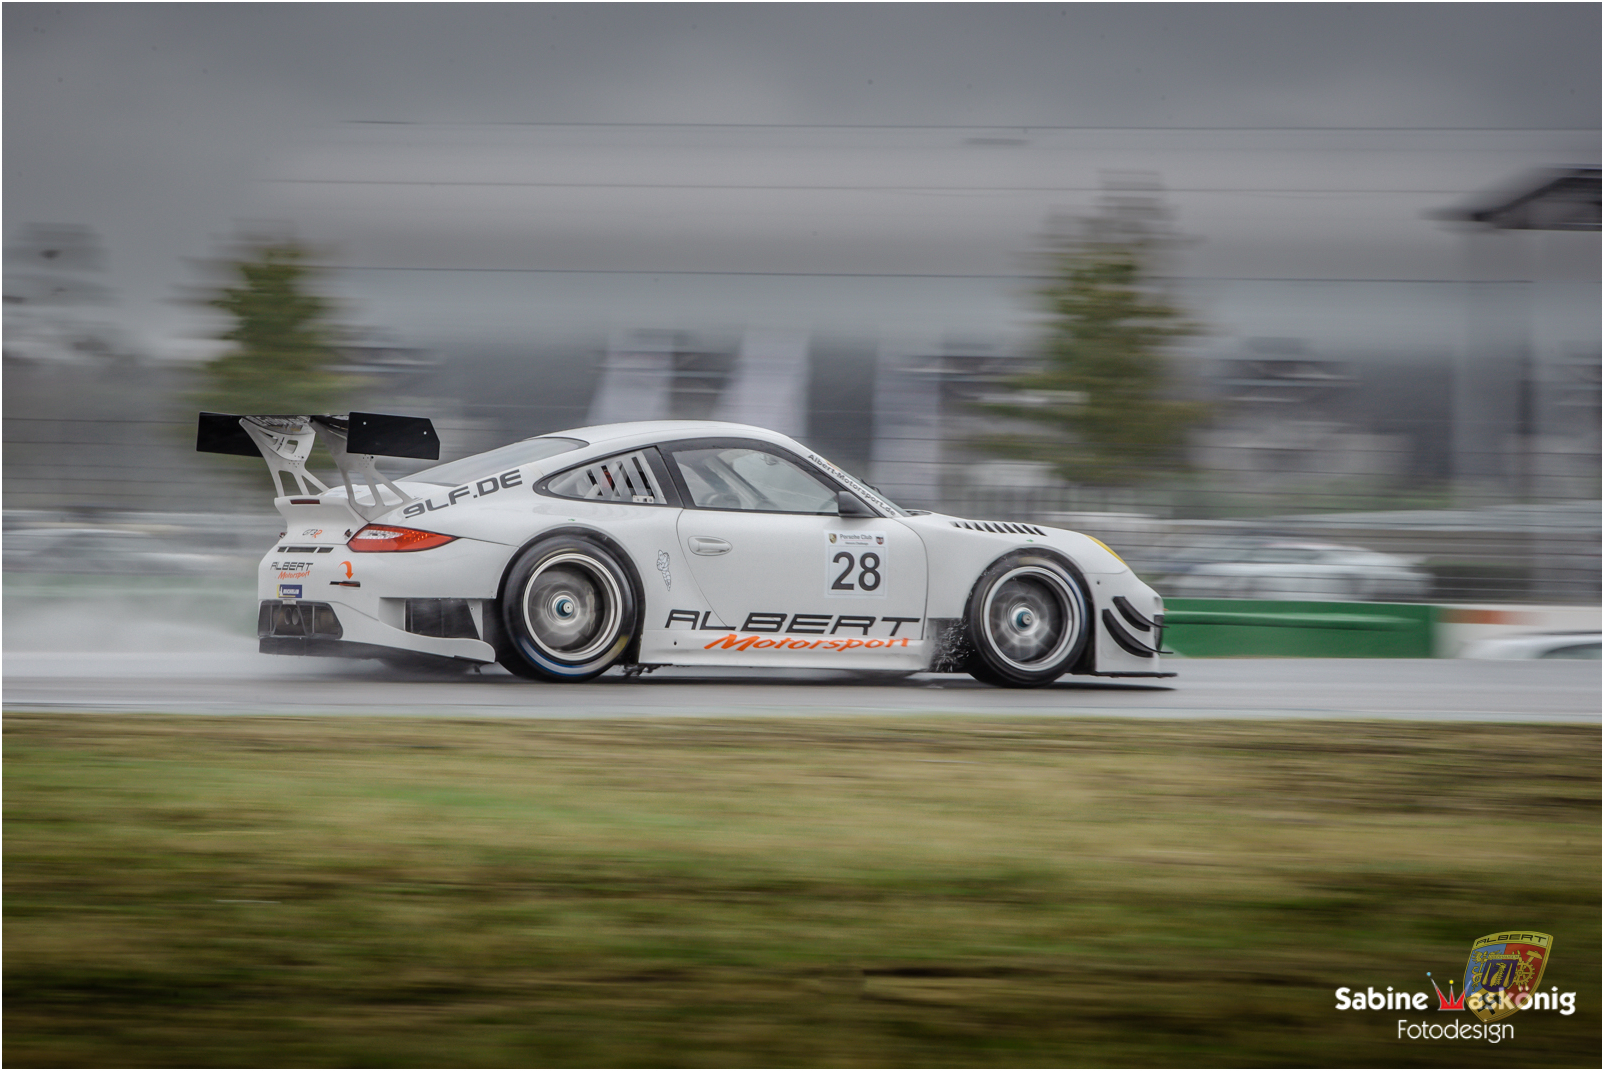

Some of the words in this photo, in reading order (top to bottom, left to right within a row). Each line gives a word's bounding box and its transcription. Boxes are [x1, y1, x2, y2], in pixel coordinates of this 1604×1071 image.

[403, 469, 523, 519] 9LF.DE
[807, 454, 896, 516] Albert-Motorsport.de
[270, 562, 314, 571] ALBERT
[277, 570, 311, 580] Motorsport
[831, 551, 881, 591] 28
[664, 609, 921, 637] ALBERT
[703, 633, 909, 652] Motorsport
